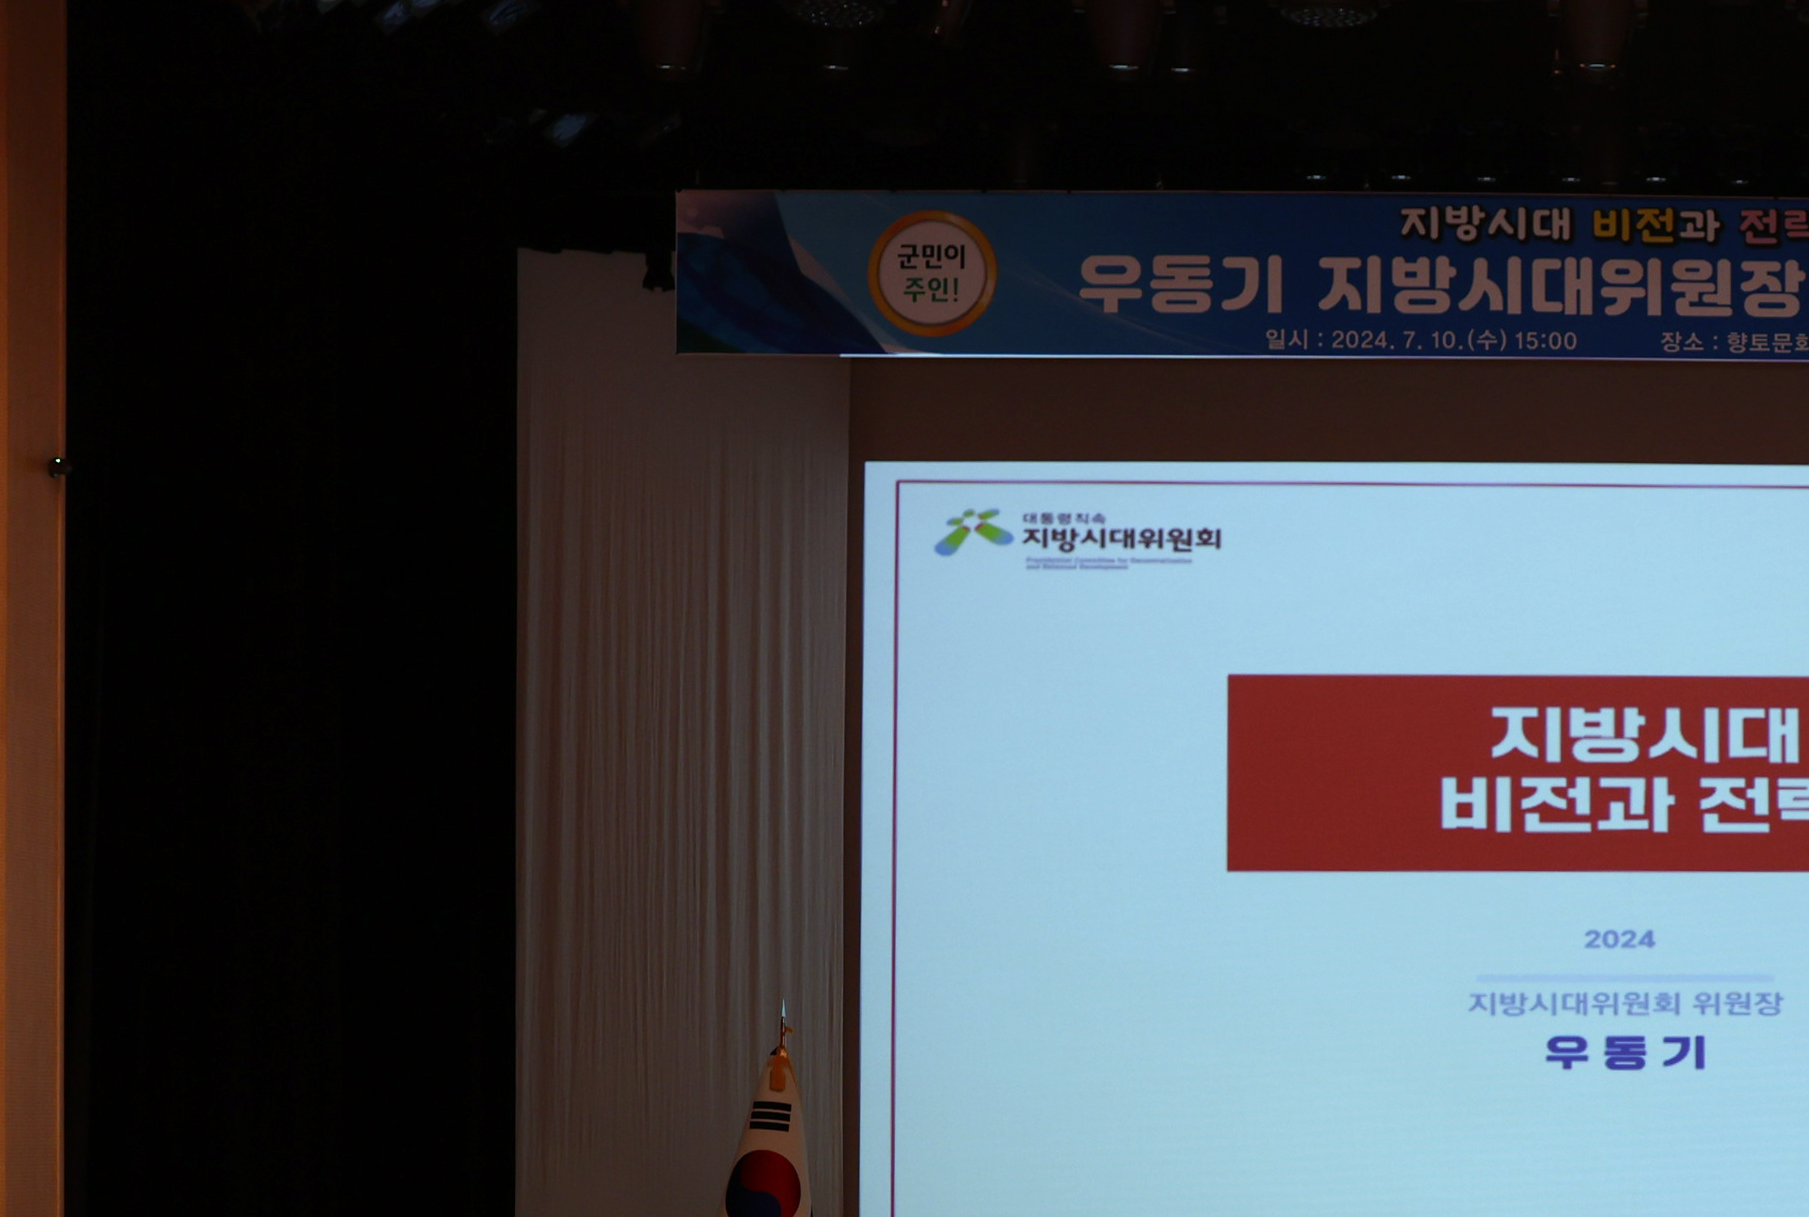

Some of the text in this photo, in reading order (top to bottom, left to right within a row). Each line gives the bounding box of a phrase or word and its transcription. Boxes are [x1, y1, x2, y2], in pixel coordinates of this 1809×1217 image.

[1400, 204, 1571, 242] 지방시대
[1593, 207, 1721, 243] 비전과
[897, 243, 966, 270] 군민이
[903, 277, 959, 303] 주인!
[1079, 254, 1283, 315] 우동기
[1318, 255, 1807, 318] 지방시대위원장
[1265, 328, 1309, 350] 일시
[1332, 329, 1395, 350] 2024.
[1403, 330, 1423, 350] 7.
[1431, 328, 1507, 352] 10.(수)
[1515, 331, 1578, 351] 15:00
[1661, 331, 1705, 353] 장소
[1022, 527, 1221, 554] 지방시대위원회
[1491, 706, 1799, 764] 지방시대
[1441, 776, 1676, 833] 비전과
[1584, 929, 1656, 949] 2024
[1468, 991, 1784, 1017] 지방시대위원회 위원장
